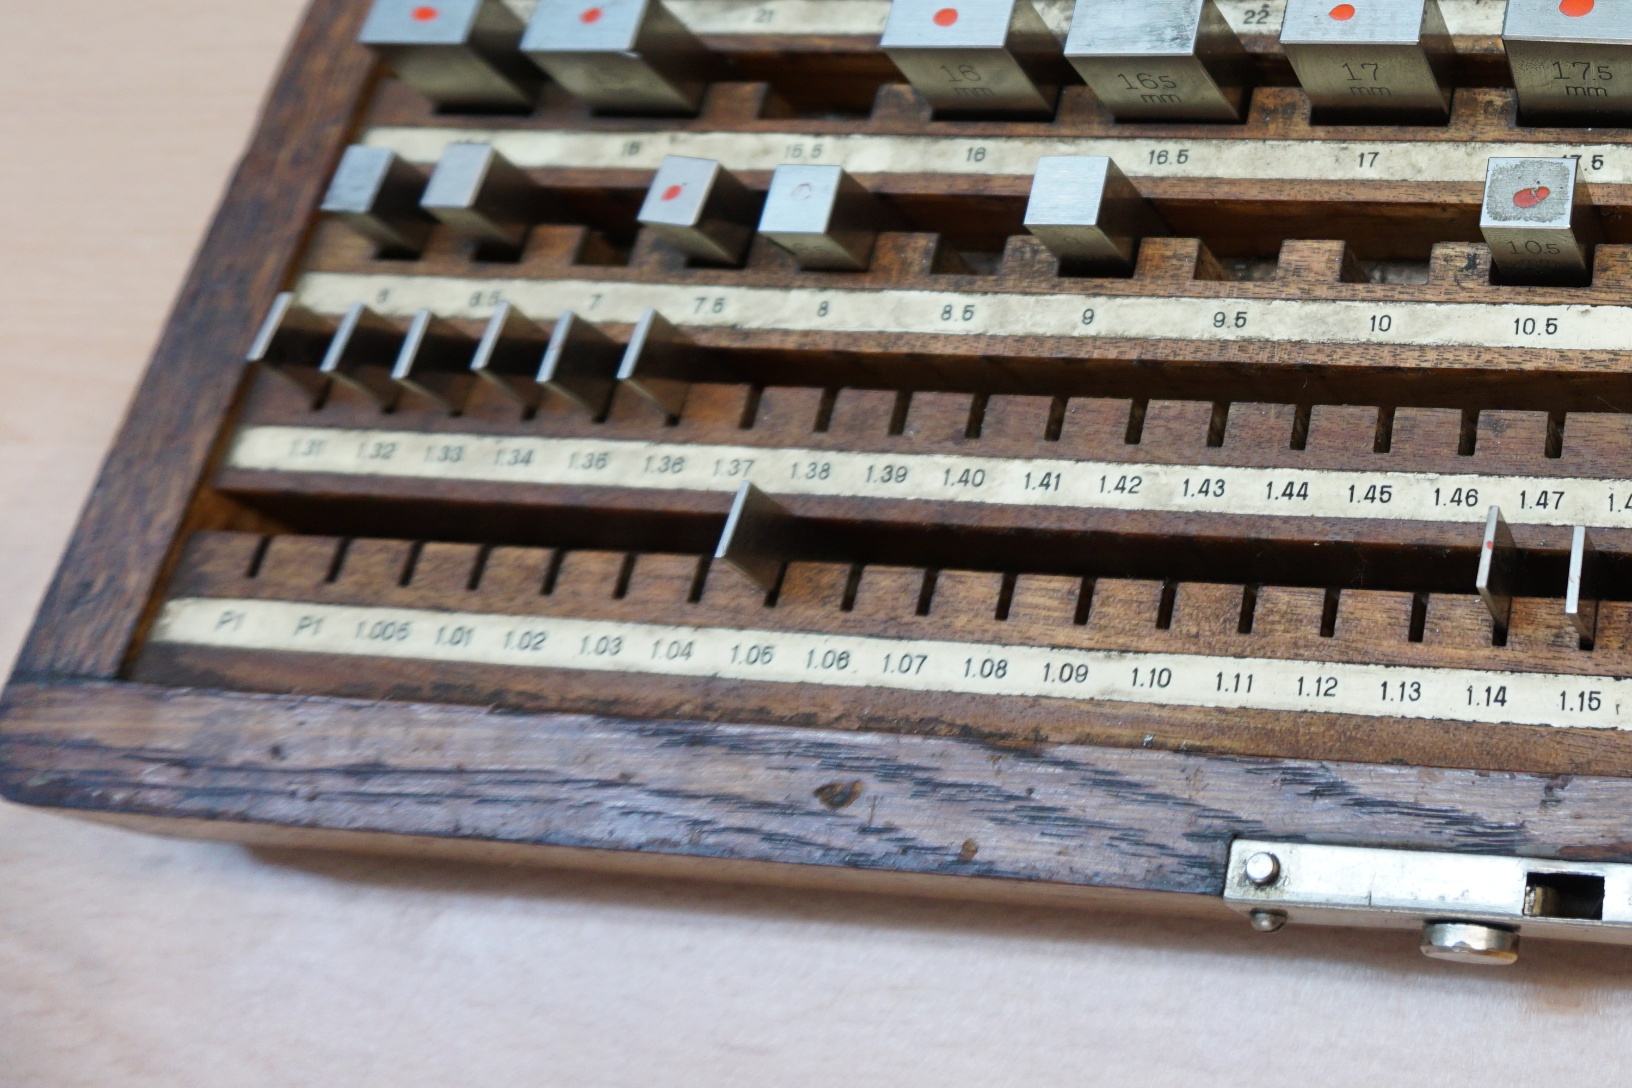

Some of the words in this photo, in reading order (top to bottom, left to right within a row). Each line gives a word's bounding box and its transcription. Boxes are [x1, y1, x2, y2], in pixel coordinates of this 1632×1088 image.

[1243, 9, 1271, 25] 22
[939, 64, 982, 82] 16
[1342, 62, 1379, 81] 17
[1141, 93, 1182, 104] mm
[1349, 86, 1391, 97] mm
[1565, 85, 1608, 97] mm
[966, 146, 987, 163] 16
[1148, 148, 1190, 166] 16.5
[1358, 151, 1380, 168] 17
[589, 292, 605, 311] 7
[694, 295, 726, 314] 7.5
[816, 300, 830, 318] 8
[940, 303, 976, 322] 8.5
[1081, 307, 1095, 326] 9
[1212, 310, 1248, 329] 9.5
[1370, 314, 1392, 333] 10
[1514, 317, 1558, 336] 10.5
[356, 439, 396, 462] 1.32
[423, 442, 464, 464] 1.33
[493, 448, 535, 467] 1.34
[567, 450, 608, 472] 1.35
[644, 454, 687, 475] 1.36
[713, 458, 757, 478] 1.37
[790, 461, 832, 481] 1.38
[866, 464, 909, 484] 1.39
[943, 467, 986, 488] 1.40
[1024, 471, 1062, 492] 1.41
[1099, 474, 1143, 495] 1.42
[1183, 478, 1226, 498] 1.43
[1266, 480, 1309, 501] 1.44
[1348, 484, 1393, 504] 1.45
[1434, 487, 1479, 508] 1.46
[1520, 490, 1565, 510] 1.47
[215, 609, 245, 630] P1
[293, 614, 325, 636] P1
[355, 619, 412, 642] 1.005
[435, 625, 475, 647] 1.01
[504, 630, 548, 652] 1.02
[580, 635, 624, 657] 1.03
[651, 638, 696, 661] 1.04
[731, 644, 775, 666] 1.05
[806, 648, 851, 671] 1.06
[883, 653, 929, 675] 1.07
[964, 657, 1008, 679] 1.08
[1043, 662, 1089, 684] 1.09
[1132, 667, 1172, 689] 1.10
[1216, 671, 1254, 694] 1.11
[1297, 676, 1339, 698] 1.12
[1380, 680, 1421, 702] 1.13
[1466, 685, 1508, 707] 1.14
[1560, 690, 1602, 713] 1.15
